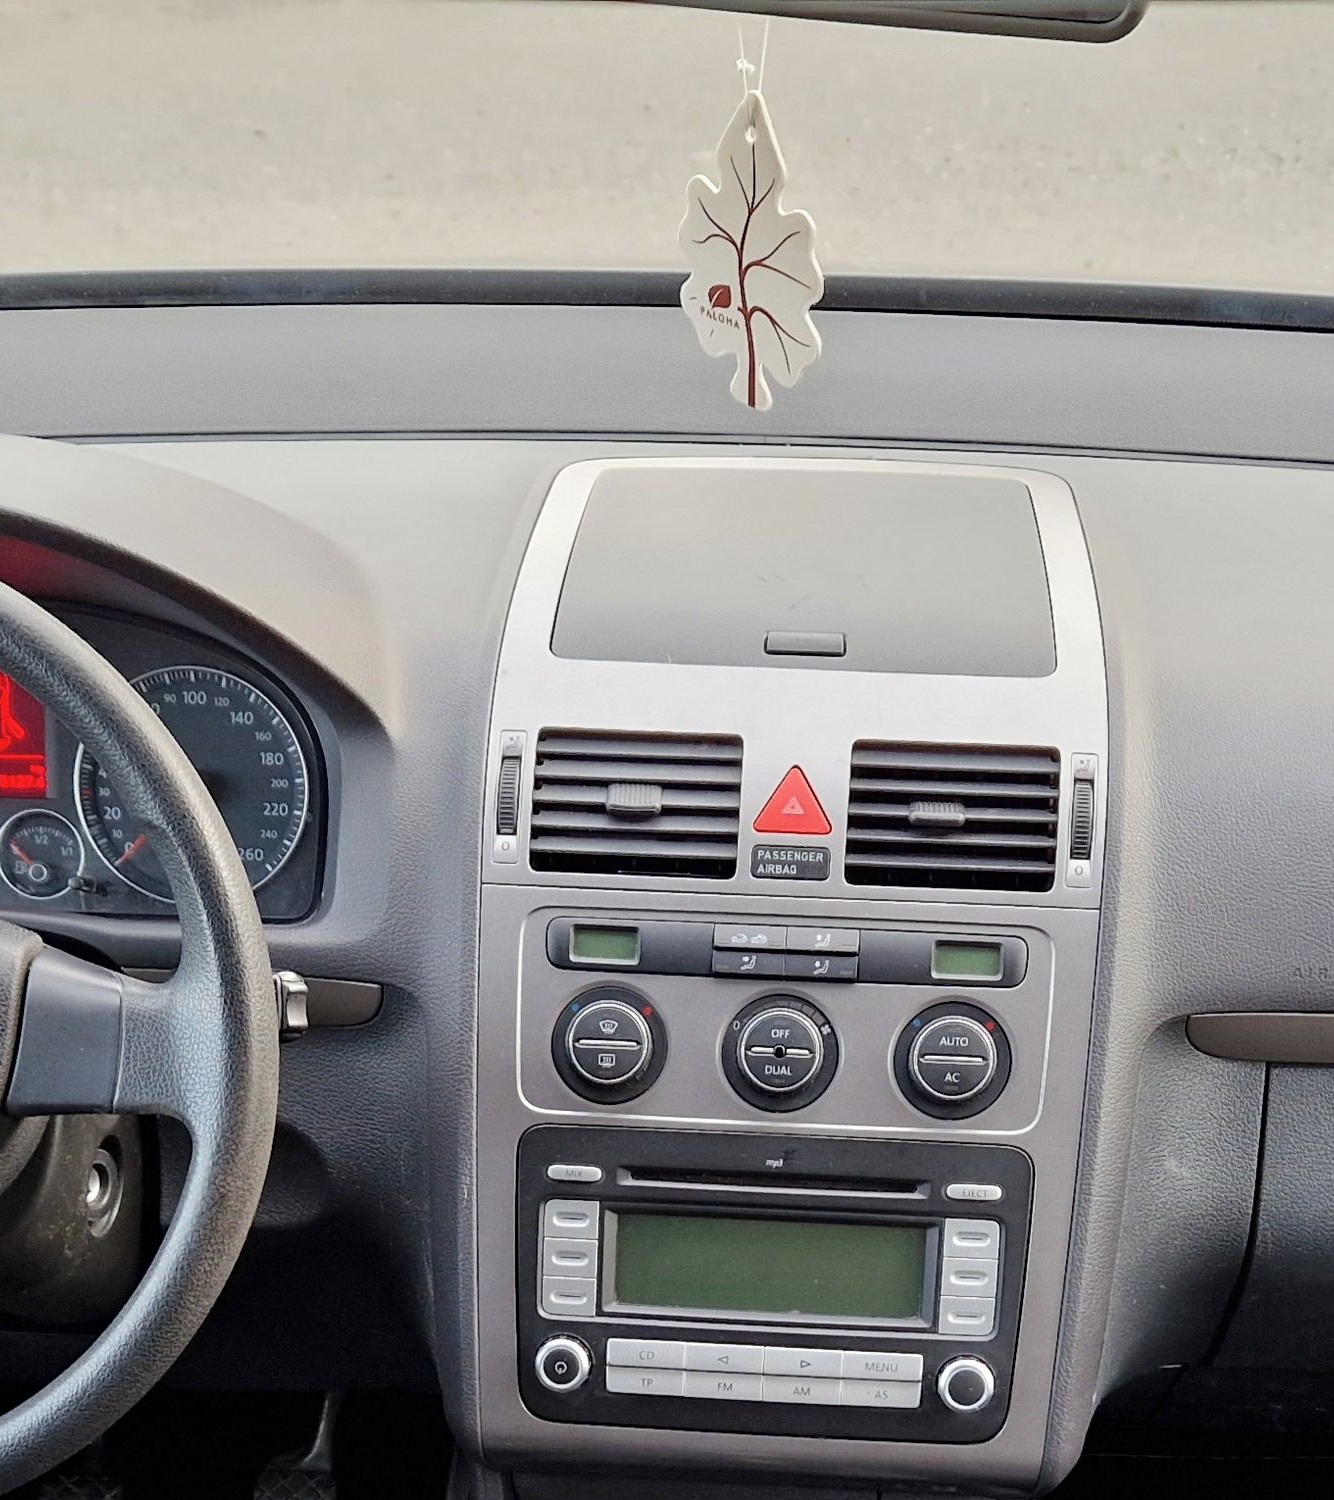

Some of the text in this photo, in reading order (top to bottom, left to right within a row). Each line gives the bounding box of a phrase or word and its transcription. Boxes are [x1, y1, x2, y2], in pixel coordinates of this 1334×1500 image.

[700, 306, 740, 330] PALOHA
[163, 693, 177, 703] 90
[182, 691, 207, 705] 100
[214, 697, 230, 707] 120
[230, 711, 254, 725] 140
[255, 731, 272, 741] 160
[259, 752, 284, 766] 180
[270, 779, 289, 788] 200
[98, 787, 111, 797] 30
[104, 806, 121, 820] 20
[263, 802, 289, 817] 220
[112, 829, 123, 839] 10
[260, 829, 278, 839] 240
[238, 847, 264, 861] 260
[757, 850, 824, 862] PASSENGER
[757, 864, 797, 875] AIRBAG
[771, 1029, 791, 1039] OFF
[939, 1036, 969, 1047] AUTO
[764, 1065, 792, 1075] DUAL
[944, 1072, 961, 1082] AC
[638, 1350, 655, 1361] CD
[865, 1361, 899, 1373] MENU
[641, 1378, 654, 1387] TP
[717, 1382, 733, 1392] FM
[793, 1386, 811, 1396] AM
[874, 1390, 889, 1400] AS
